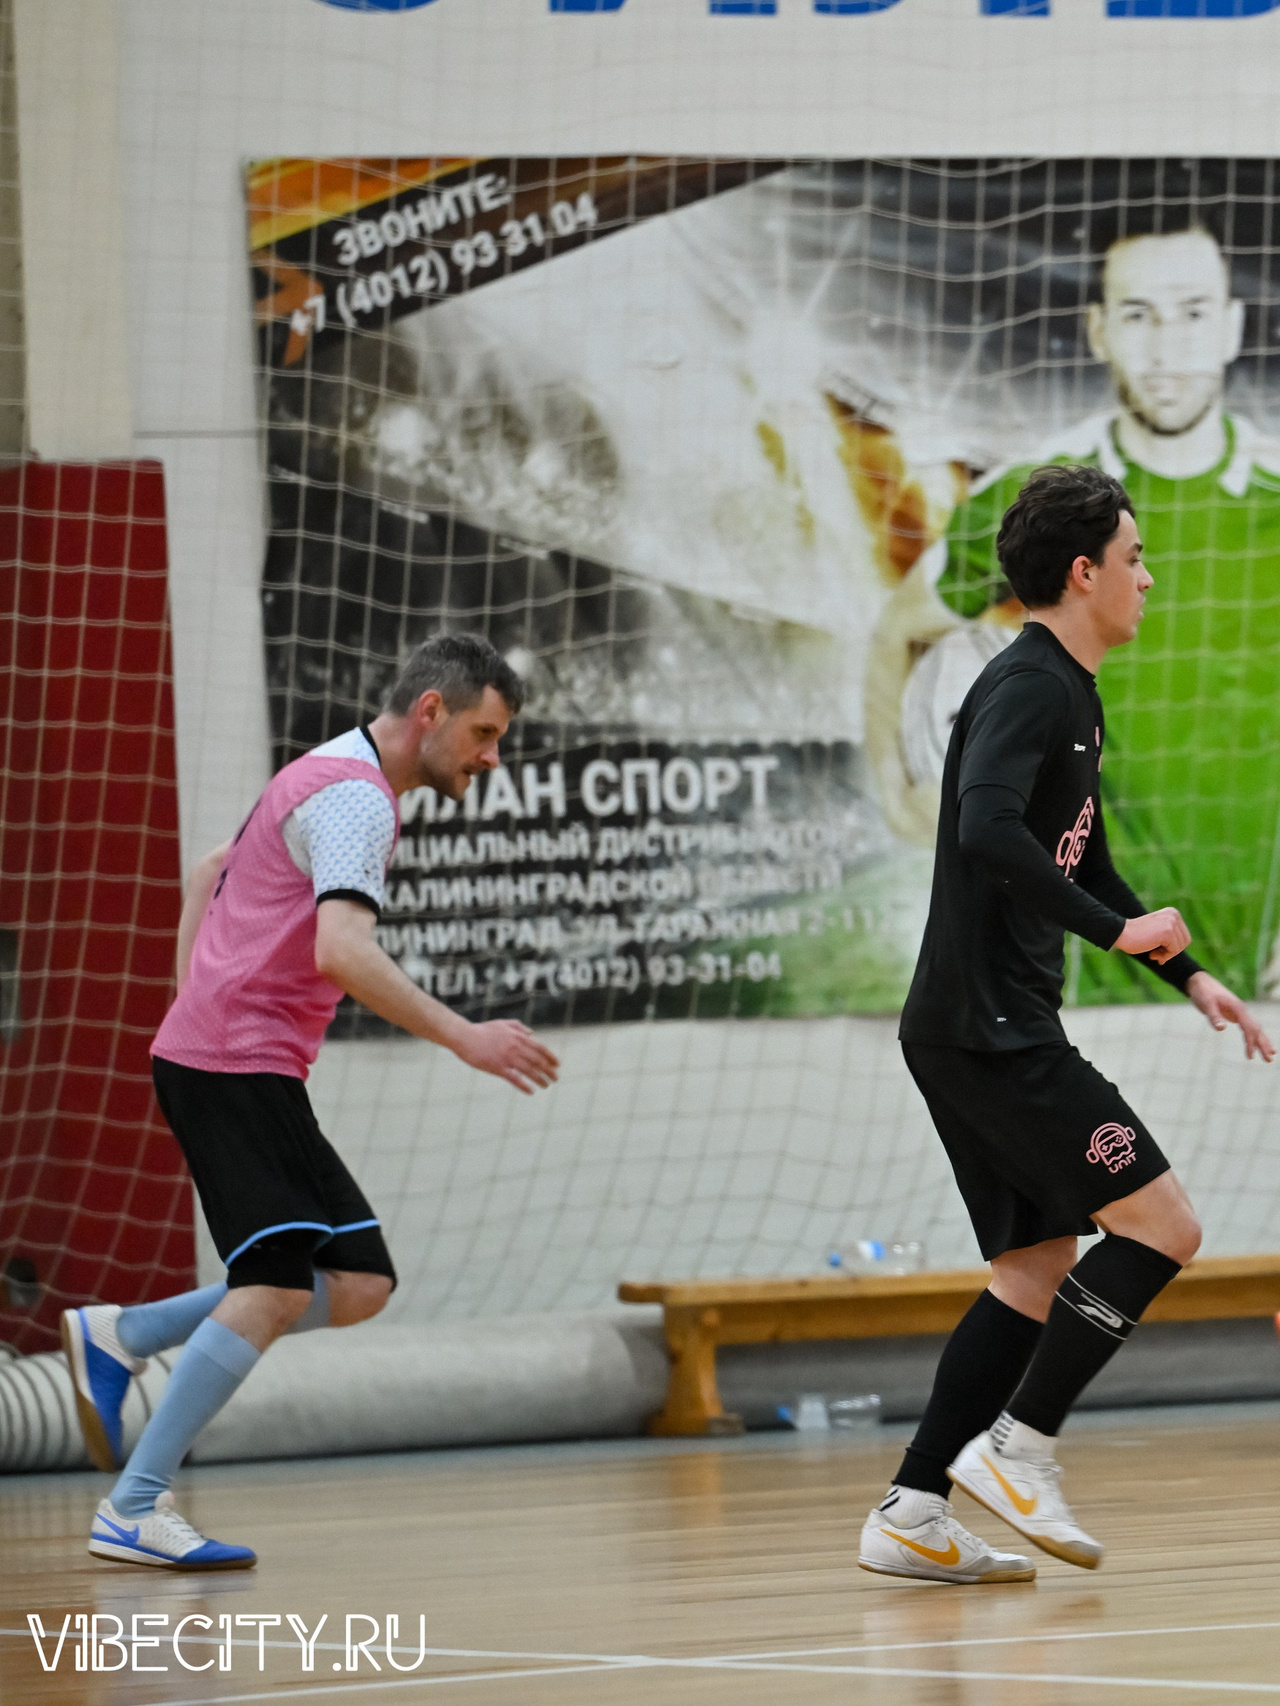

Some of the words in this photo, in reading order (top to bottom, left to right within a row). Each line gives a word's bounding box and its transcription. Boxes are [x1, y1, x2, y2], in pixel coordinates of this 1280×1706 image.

[332, 171, 515, 266] ЗВОНИТЕ:
[290, 293, 326, 337] +7
[336, 248, 449, 329] (4012)
[451, 230, 499, 275] 93
[501, 212, 546, 257] 31
[551, 192, 599, 236] 04
[399, 760, 567, 825] ИЛАН
[580, 755, 780, 817] СПОРТ
[391, 822, 591, 872] ЦИАЛЬНЫЙ
